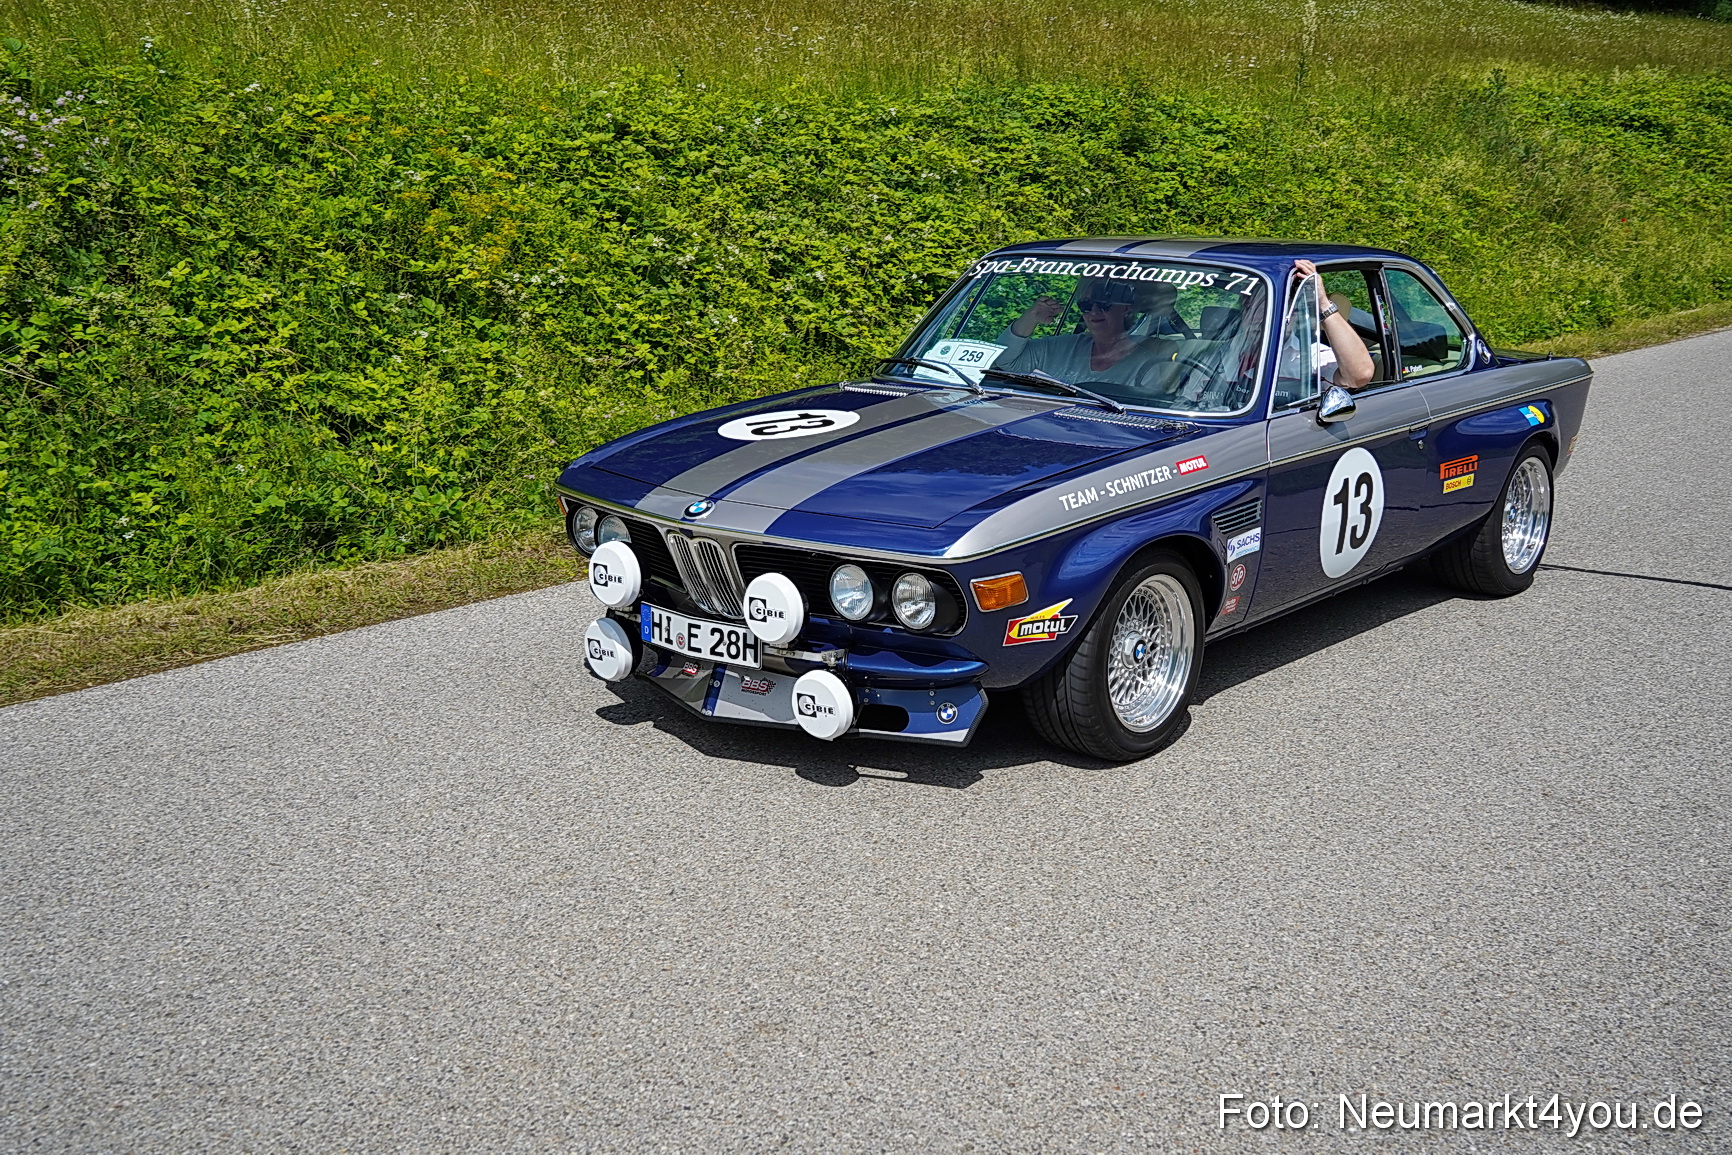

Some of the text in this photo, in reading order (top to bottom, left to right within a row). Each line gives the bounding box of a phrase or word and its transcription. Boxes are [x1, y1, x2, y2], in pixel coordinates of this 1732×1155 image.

[968, 257, 1260, 296] Spa-Francorchamps 71
[958, 349, 985, 363] 259
[745, 412, 835, 436] 13
[1179, 457, 1207, 474] MOTUL
[1440, 454, 1479, 480] PIRELLI
[1445, 479, 1462, 490] BOSCH
[1333, 471, 1374, 556] 13
[1236, 532, 1261, 550] SACHS
[1231, 566, 1244, 585] STP
[1020, 619, 1067, 636] motul
[651, 610, 674, 646] HI
[687, 622, 703, 654] E
[709, 627, 759, 664] 28H
[741, 679, 769, 691] BBS
